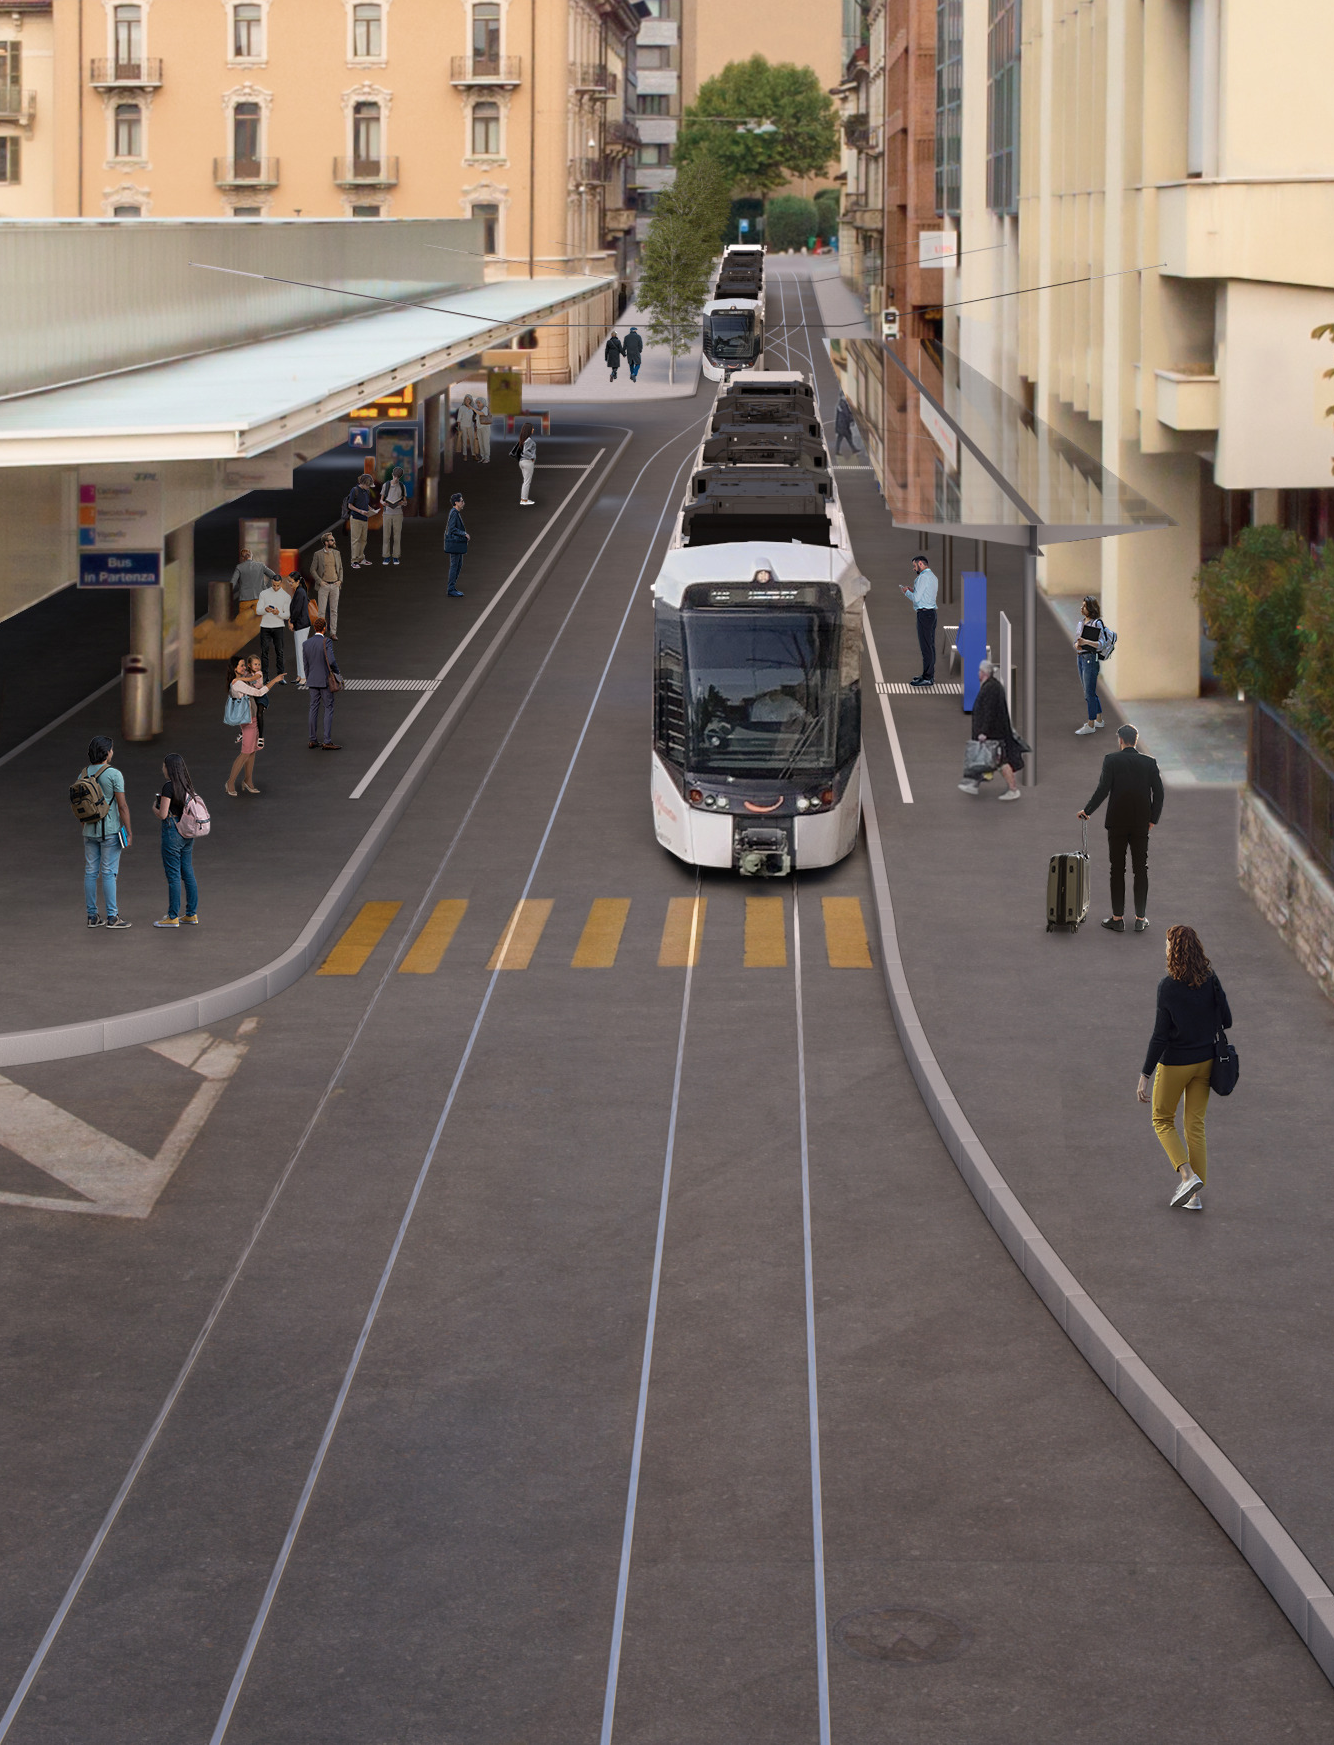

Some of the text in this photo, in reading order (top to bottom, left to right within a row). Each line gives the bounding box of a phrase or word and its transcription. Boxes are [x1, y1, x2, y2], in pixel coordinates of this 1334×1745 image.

[108, 557, 133, 568] Bus
[84, 571, 156, 583] in Partenza
